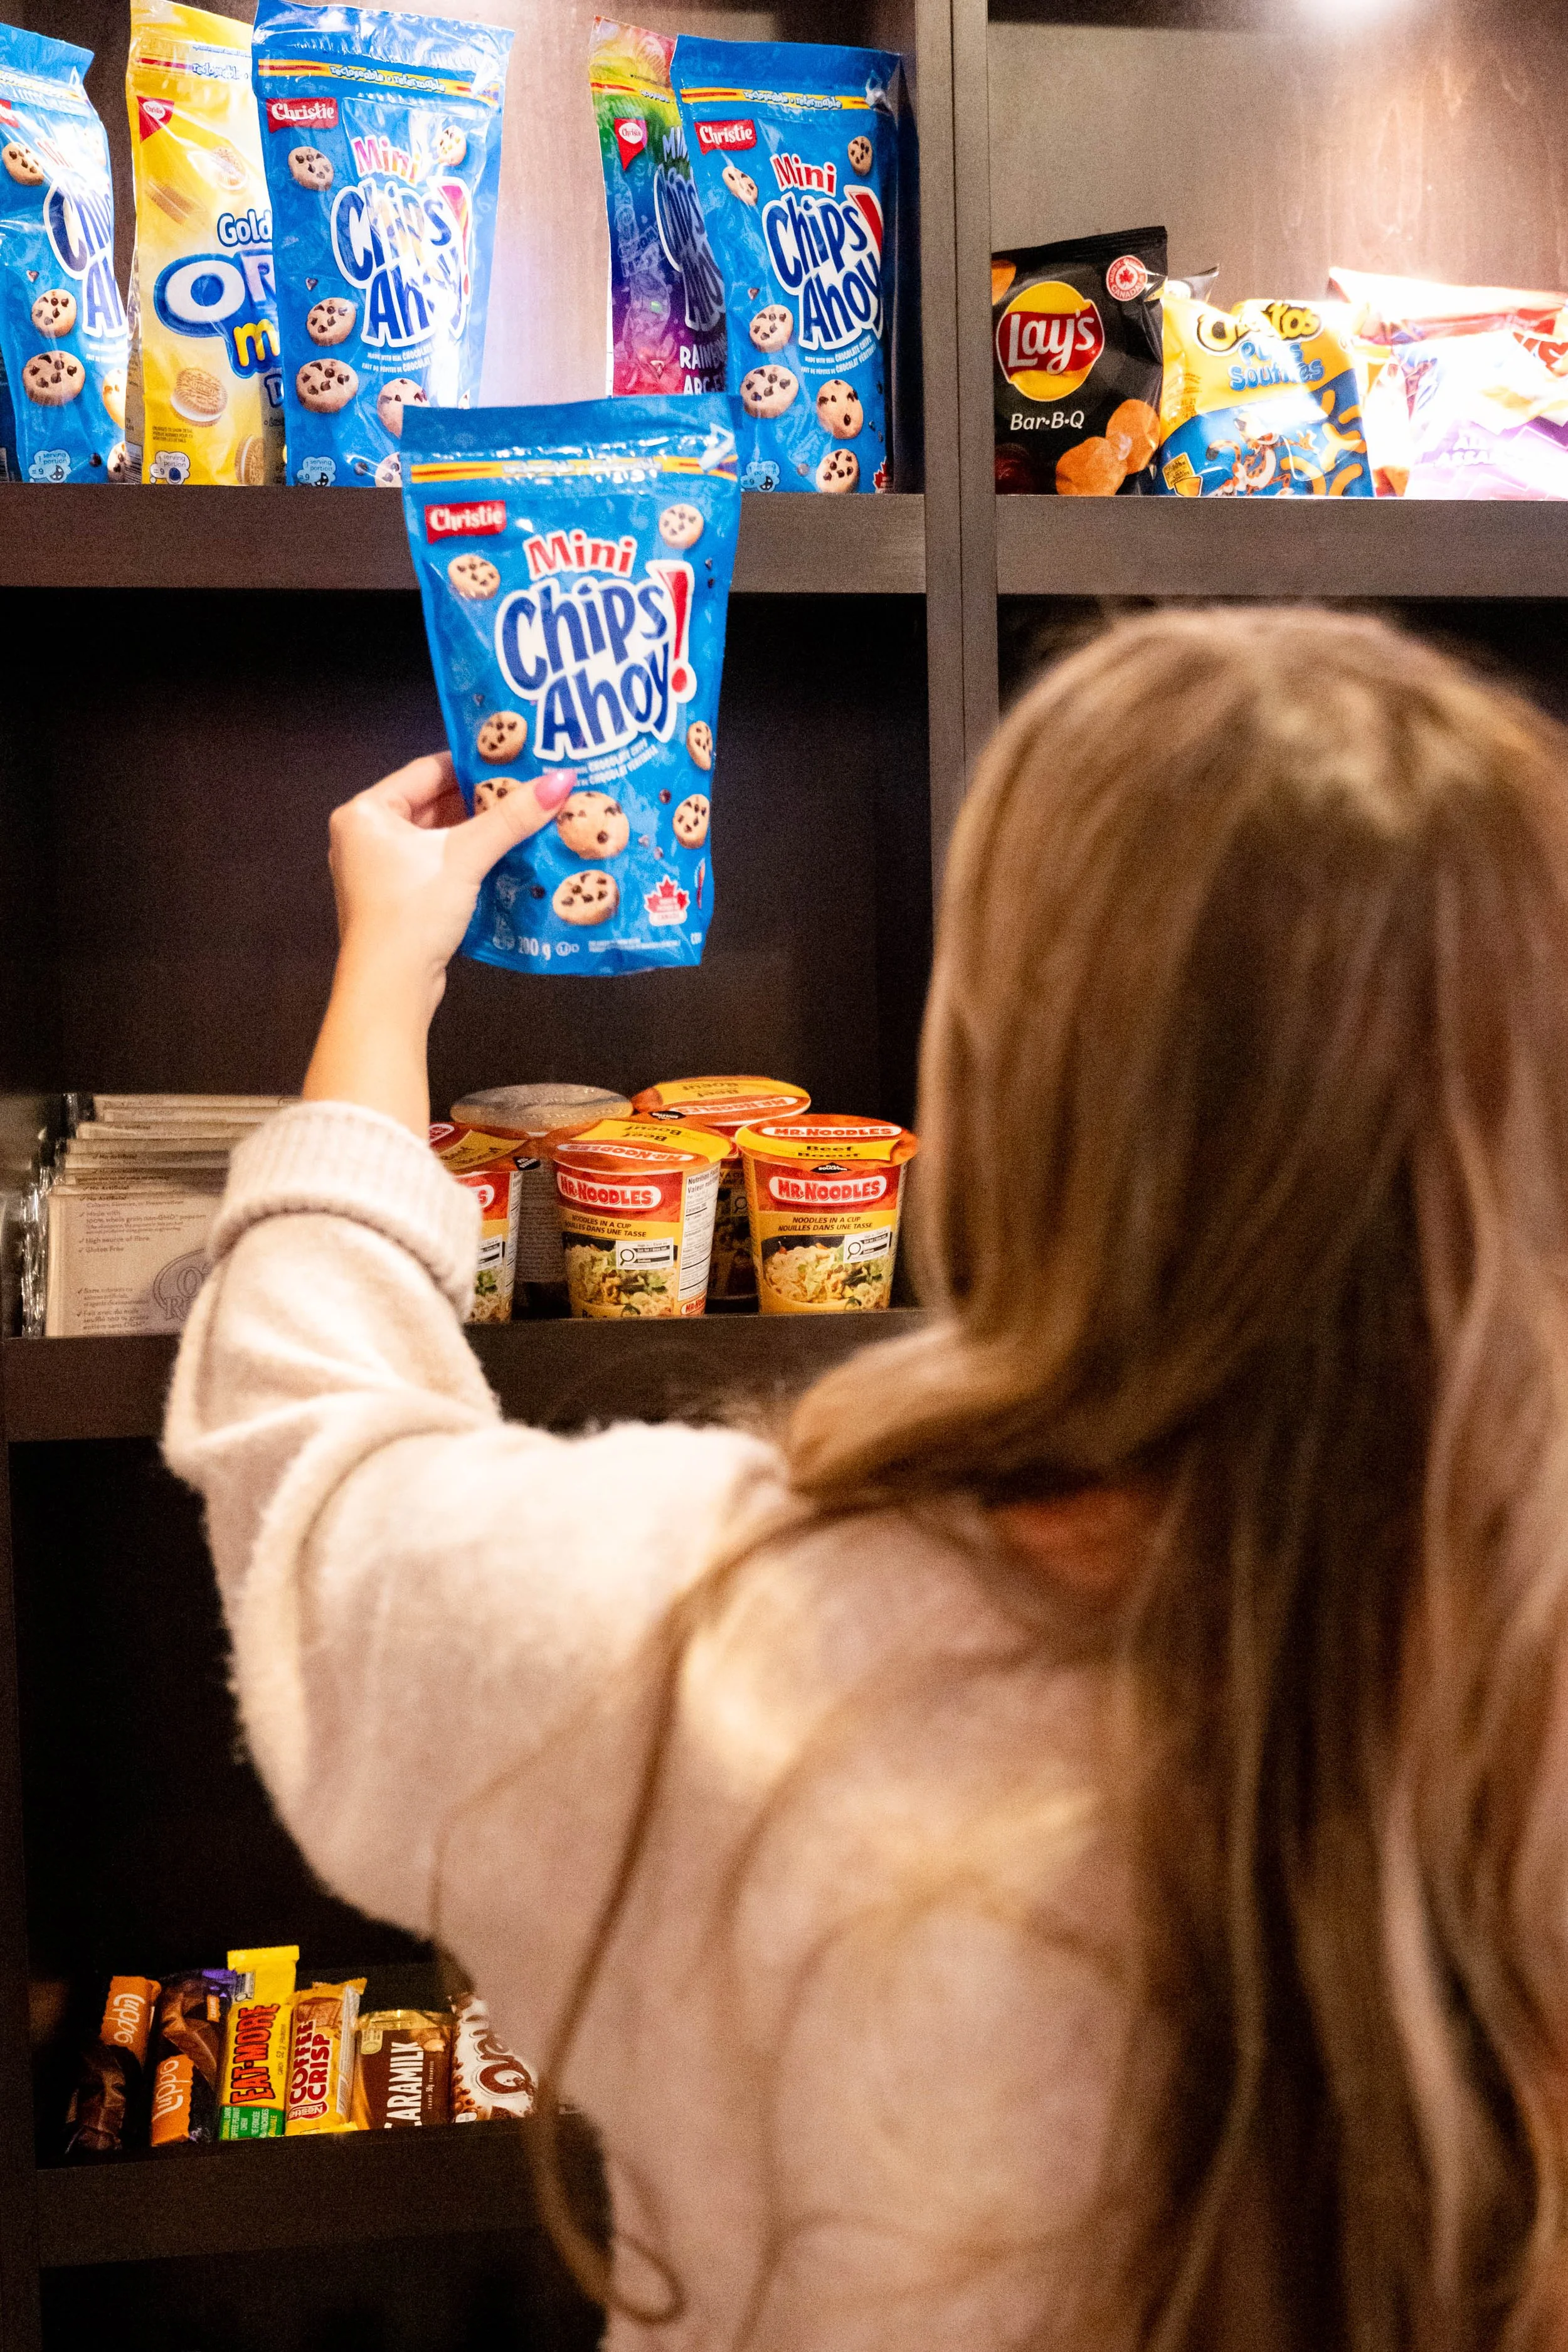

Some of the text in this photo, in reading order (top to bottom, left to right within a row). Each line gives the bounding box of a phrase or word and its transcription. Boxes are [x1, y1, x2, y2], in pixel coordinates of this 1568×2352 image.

[271, 102, 335, 121] Christie
[699, 125, 753, 146] Christie
[353, 137, 421, 184] Mini
[772, 156, 836, 194] Mini
[1111, 284, 1142, 299] CANADA
[1008, 309, 1096, 376] Lay's
[163, 454, 186, 463] serving
[430, 507, 503, 532] Christie
[527, 533, 635, 578] Mini
[501, 581, 667, 691] Chips
[622, 1133, 667, 1142] Beef
[806, 1128, 893, 1136] NOODLES
[577, 1180, 654, 1206] NOODLES
[804, 1179, 881, 1202] NOODLES
[586, 1225, 605, 1234] DANS
[607, 1227, 622, 1236] UNE
[230, 2003, 281, 2104] EAT-MORE
[276, 2050, 285, 2060] 52
[289, 2020, 314, 2104] COFFEE
[307, 2033, 331, 2101] CRISP
